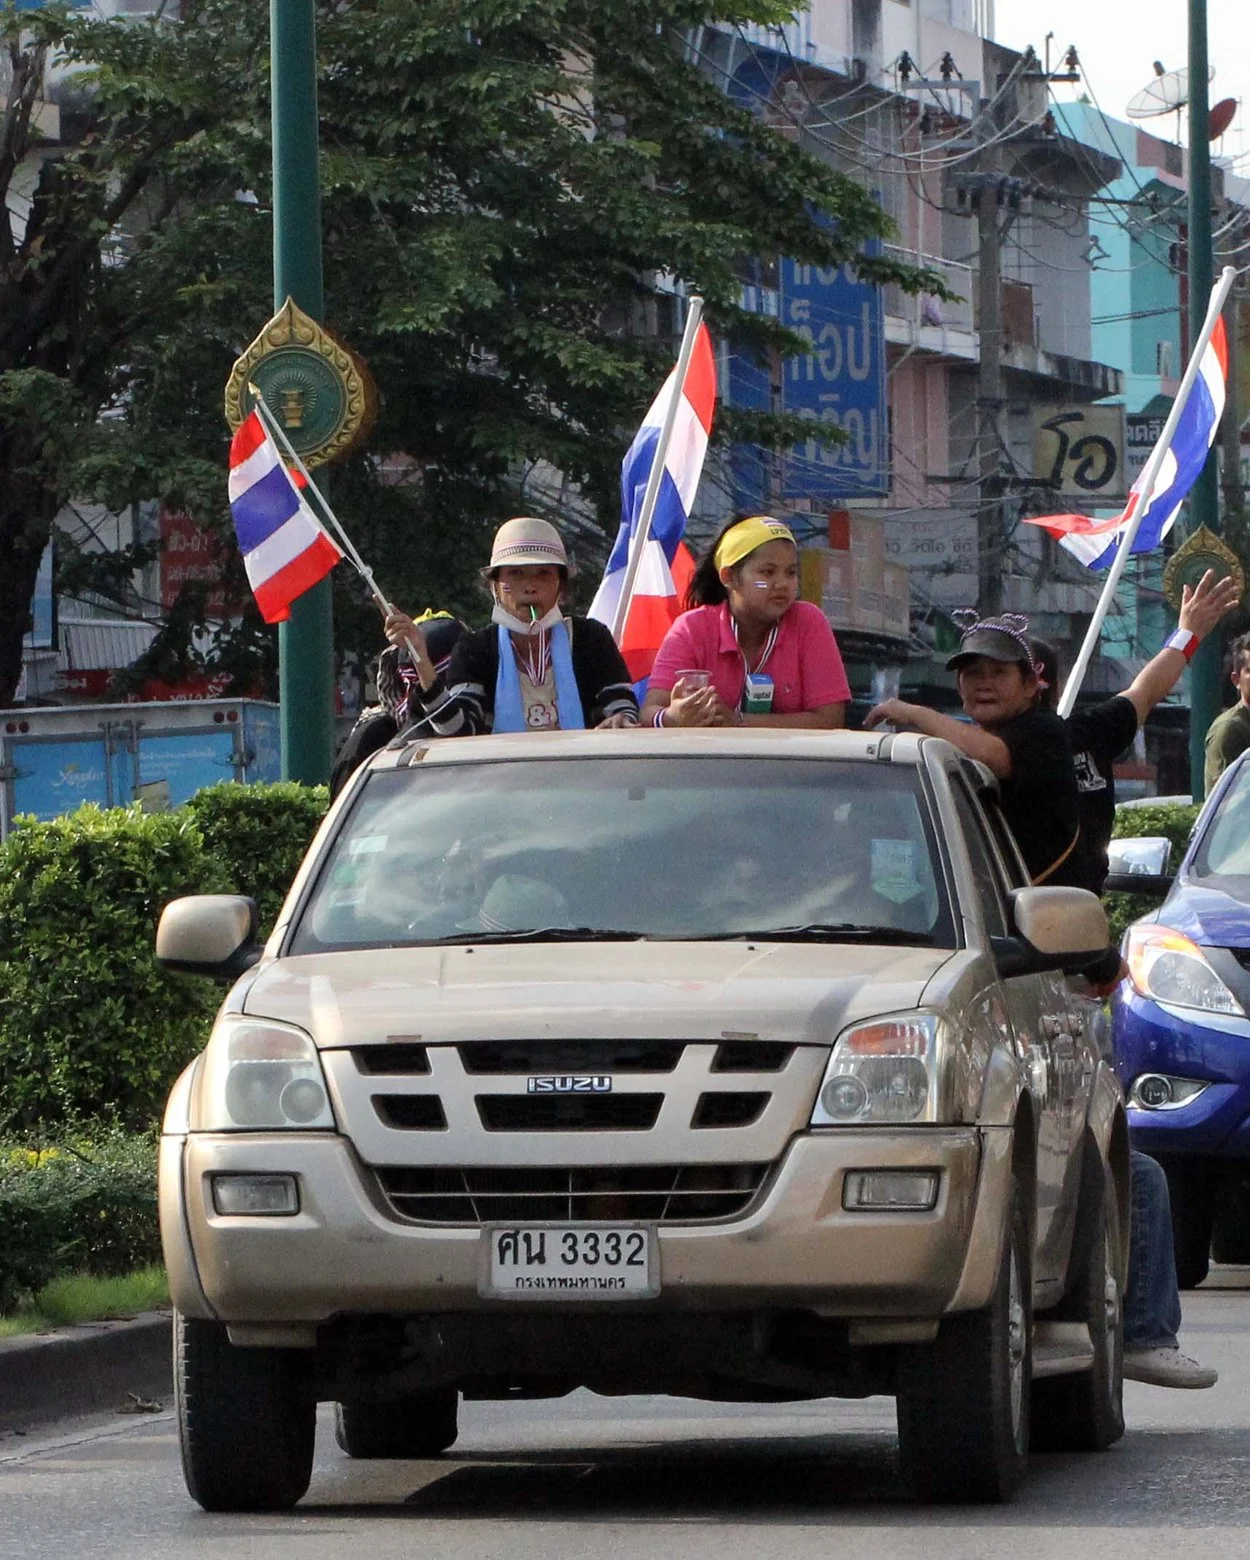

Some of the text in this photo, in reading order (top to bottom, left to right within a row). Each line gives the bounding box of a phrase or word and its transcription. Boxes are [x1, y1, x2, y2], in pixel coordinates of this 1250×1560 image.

[1041, 402, 1117, 490] โอ
[528, 1077, 611, 1091] ISUZU
[498, 1230, 645, 1265] ศน 3332
[515, 1276, 626, 1290] กรงเทพมหานคร
